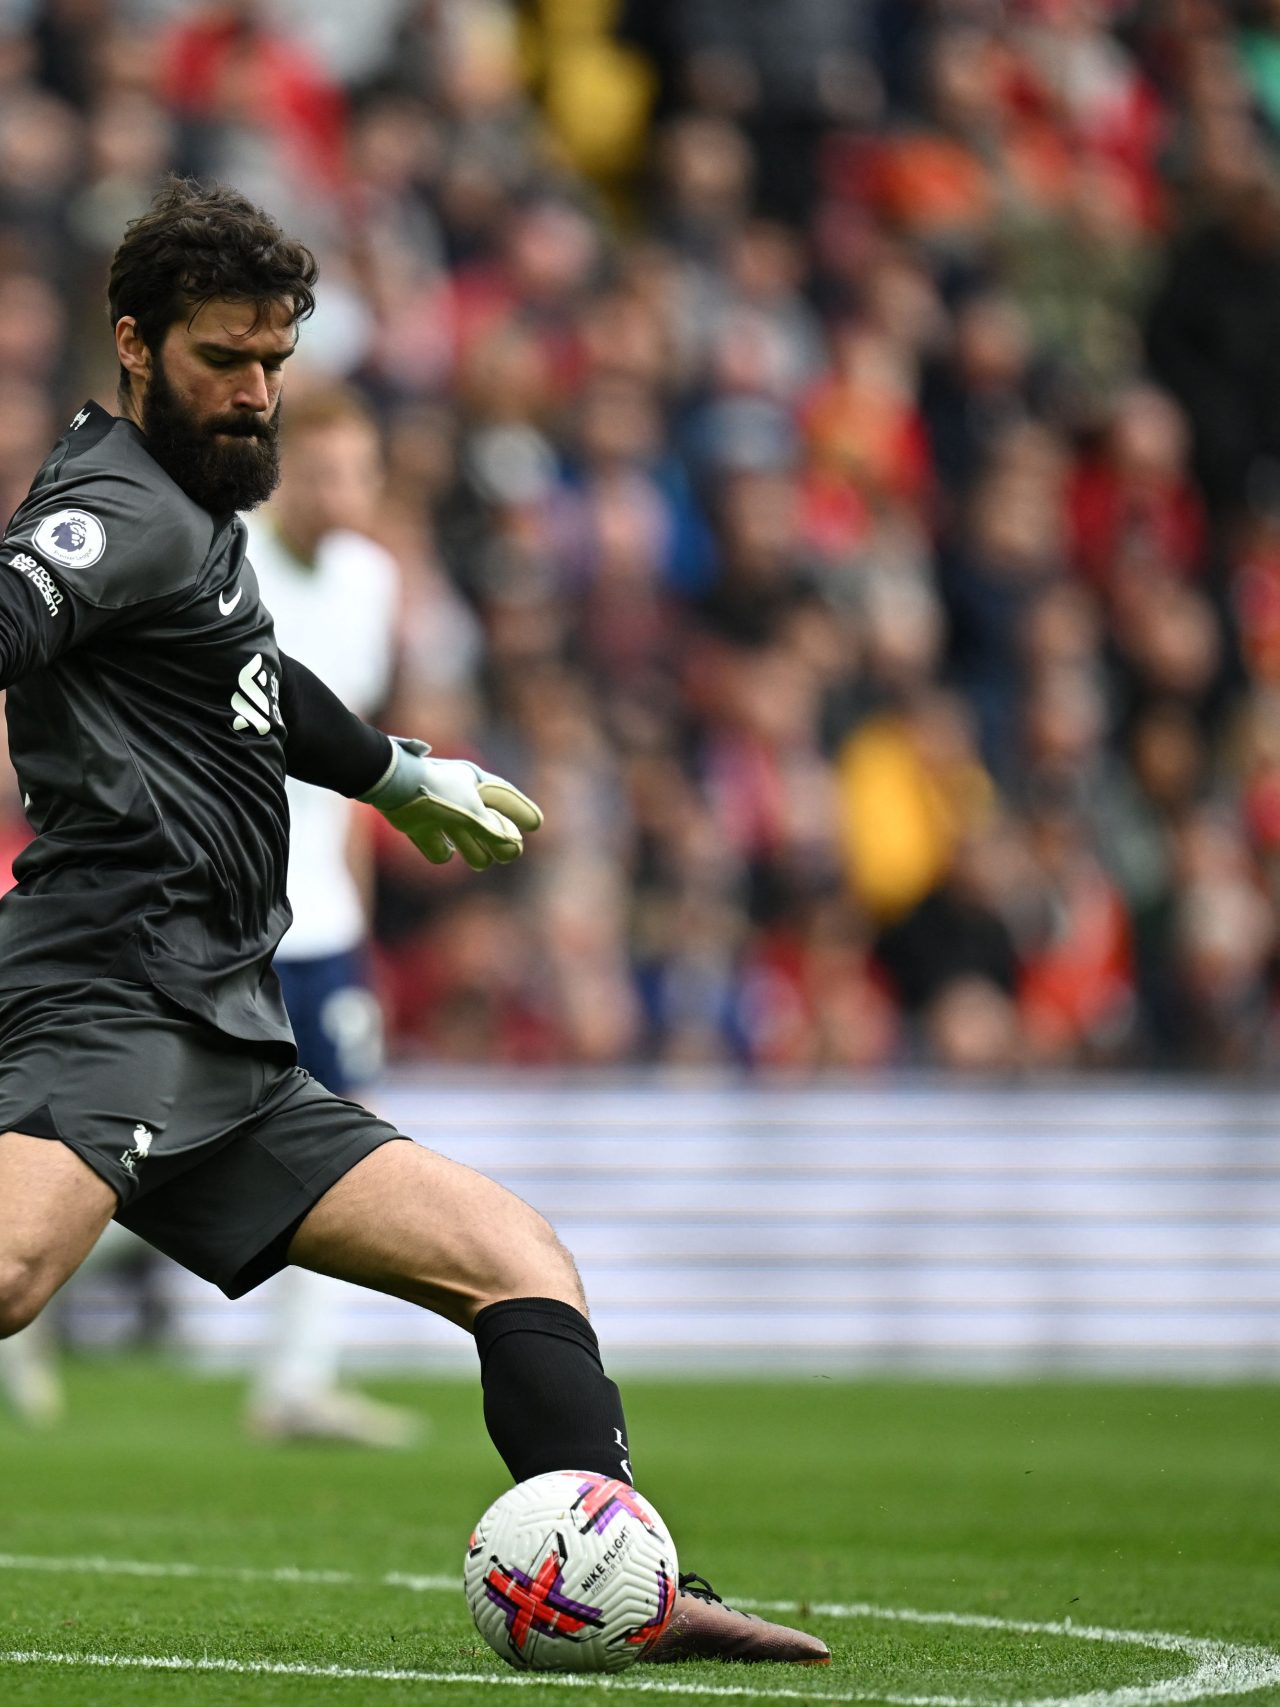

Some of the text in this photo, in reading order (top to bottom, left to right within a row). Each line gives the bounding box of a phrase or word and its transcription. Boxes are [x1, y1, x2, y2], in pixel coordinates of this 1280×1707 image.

[8, 559, 59, 617] for racism
[12, 553, 64, 605] No room
[581, 1526, 631, 1592] NIKE FLIGHT
